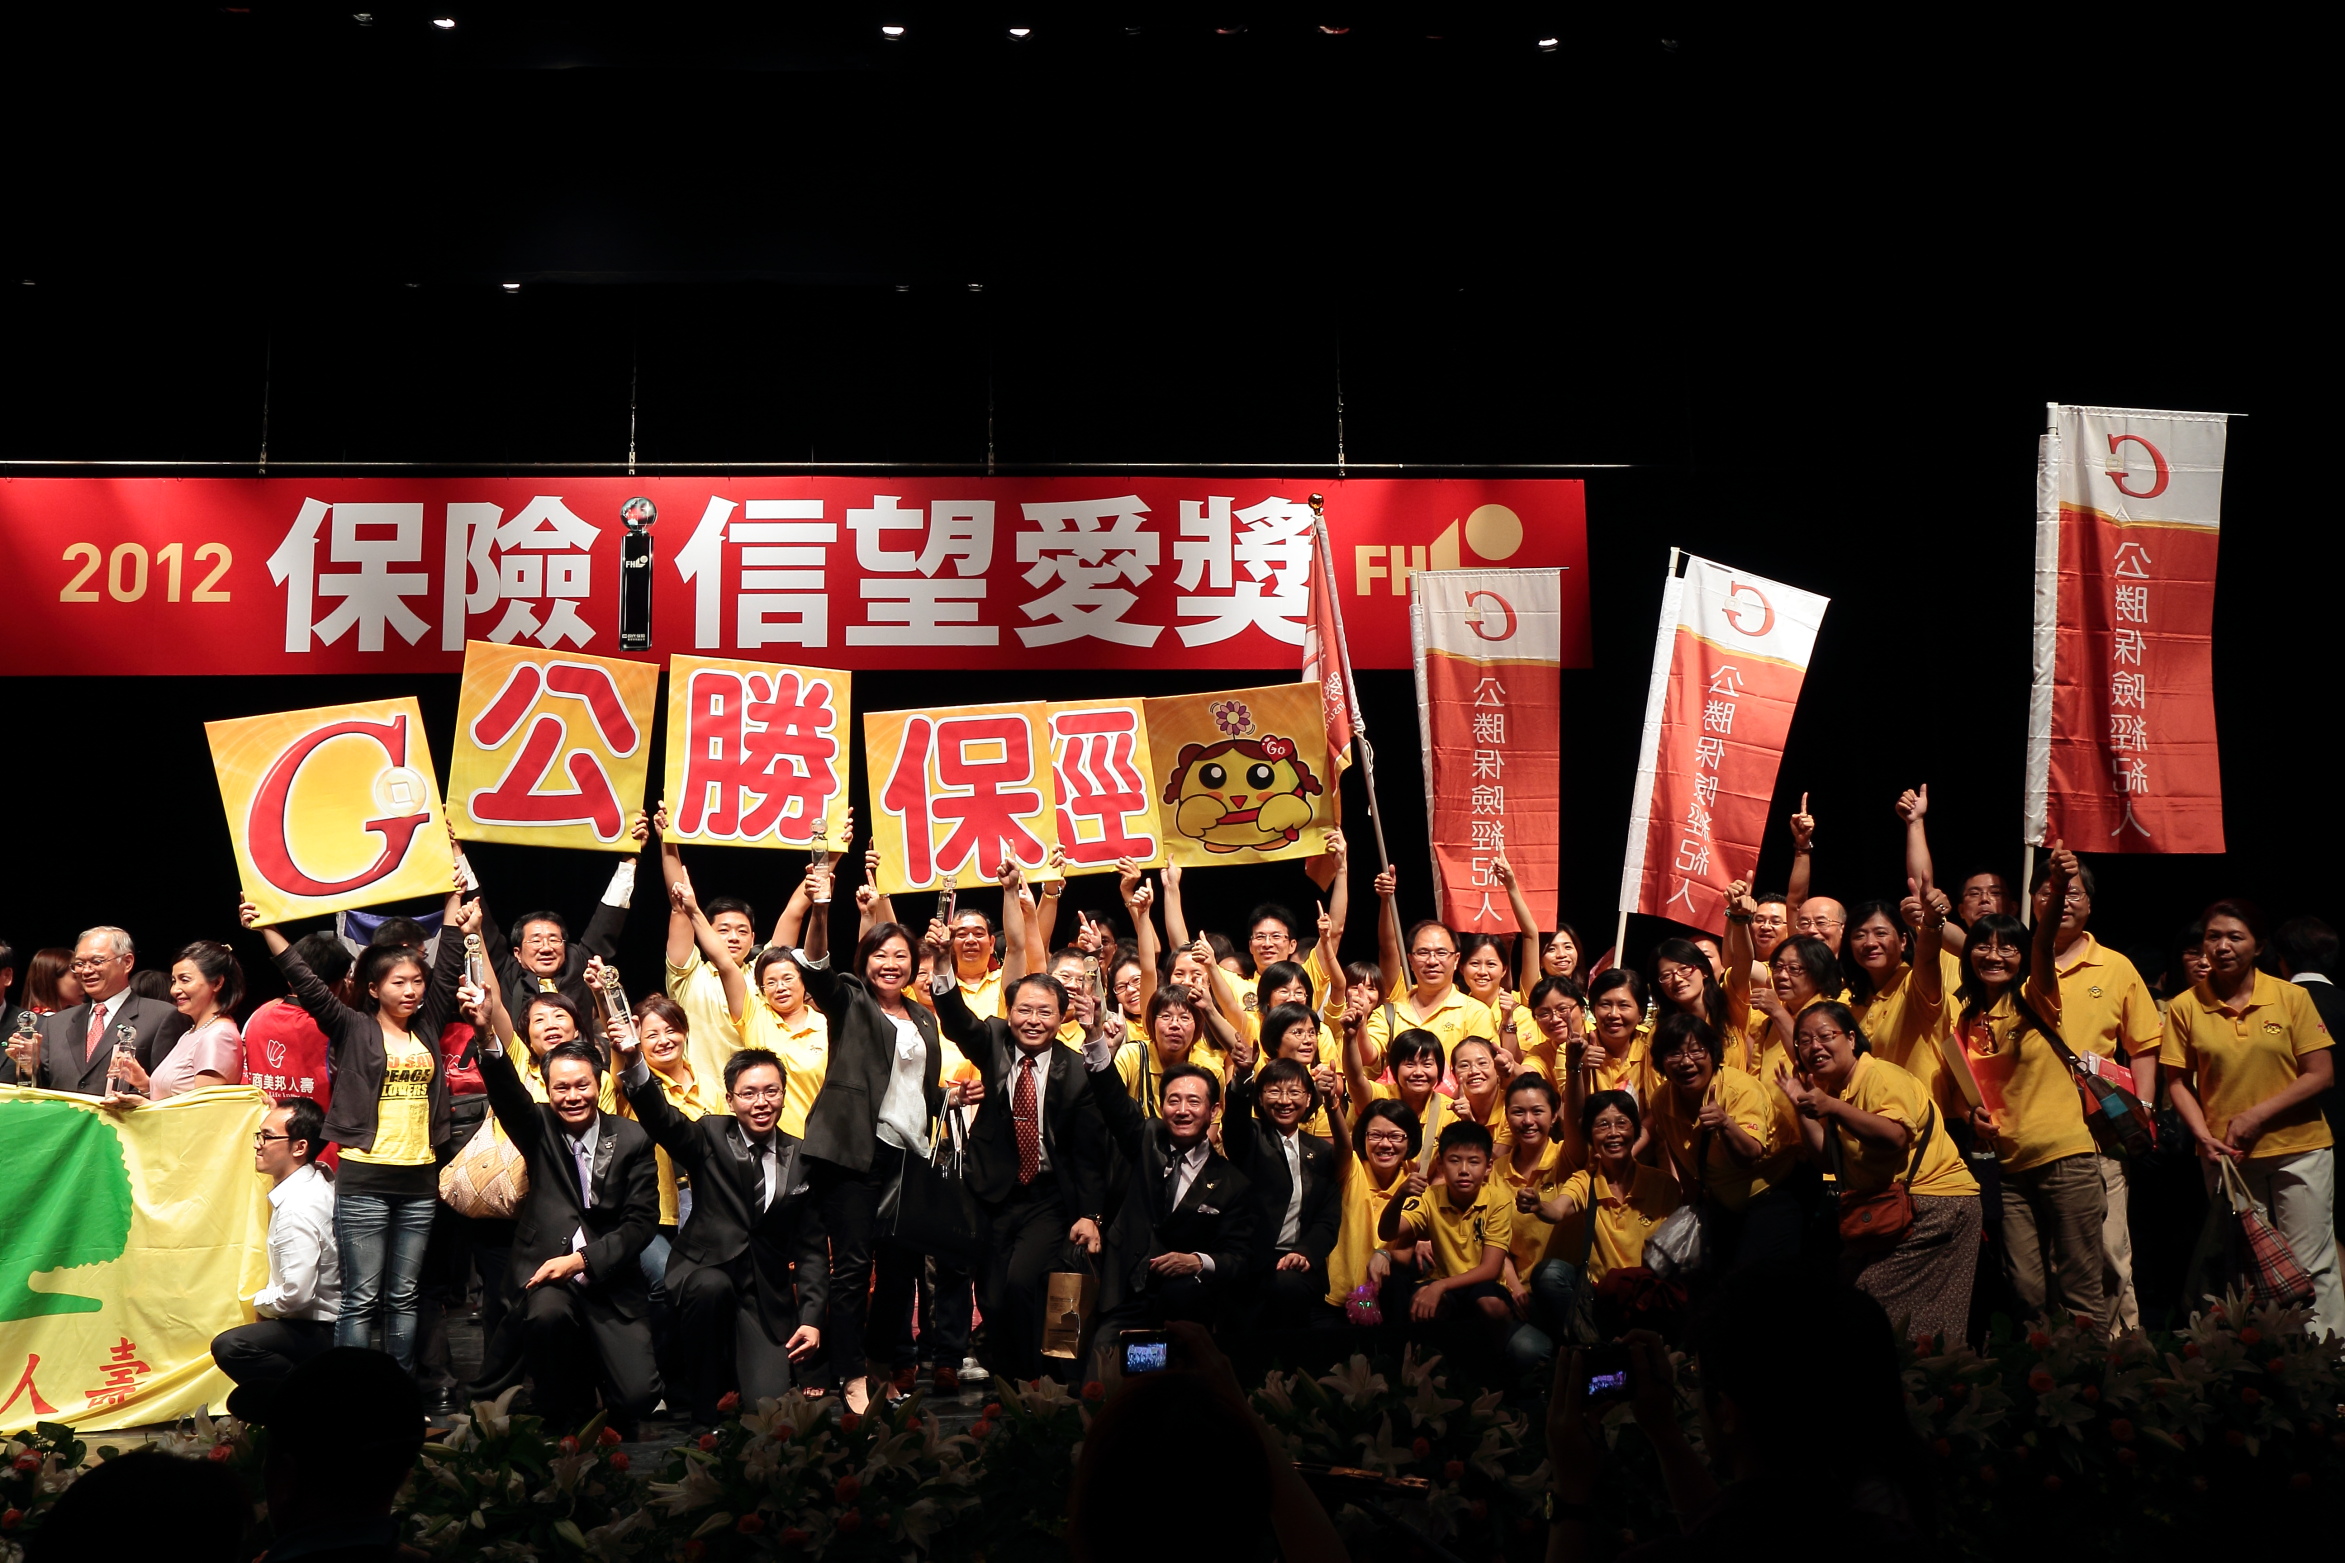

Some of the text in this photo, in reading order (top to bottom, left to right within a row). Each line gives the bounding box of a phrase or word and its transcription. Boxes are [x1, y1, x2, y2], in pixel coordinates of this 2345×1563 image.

[59, 542, 233, 603] 2012
[266, 495, 602, 653] 保險
[673, 494, 1316, 649] 信望愛獎
[248, 714, 431, 897] G
[469, 660, 642, 843] 公
[677, 668, 841, 842] 勝
[880, 710, 1049, 890] 保
[1266, 741, 1286, 755] Go
[248, 1072, 315, 1094] 商美邦人壽
